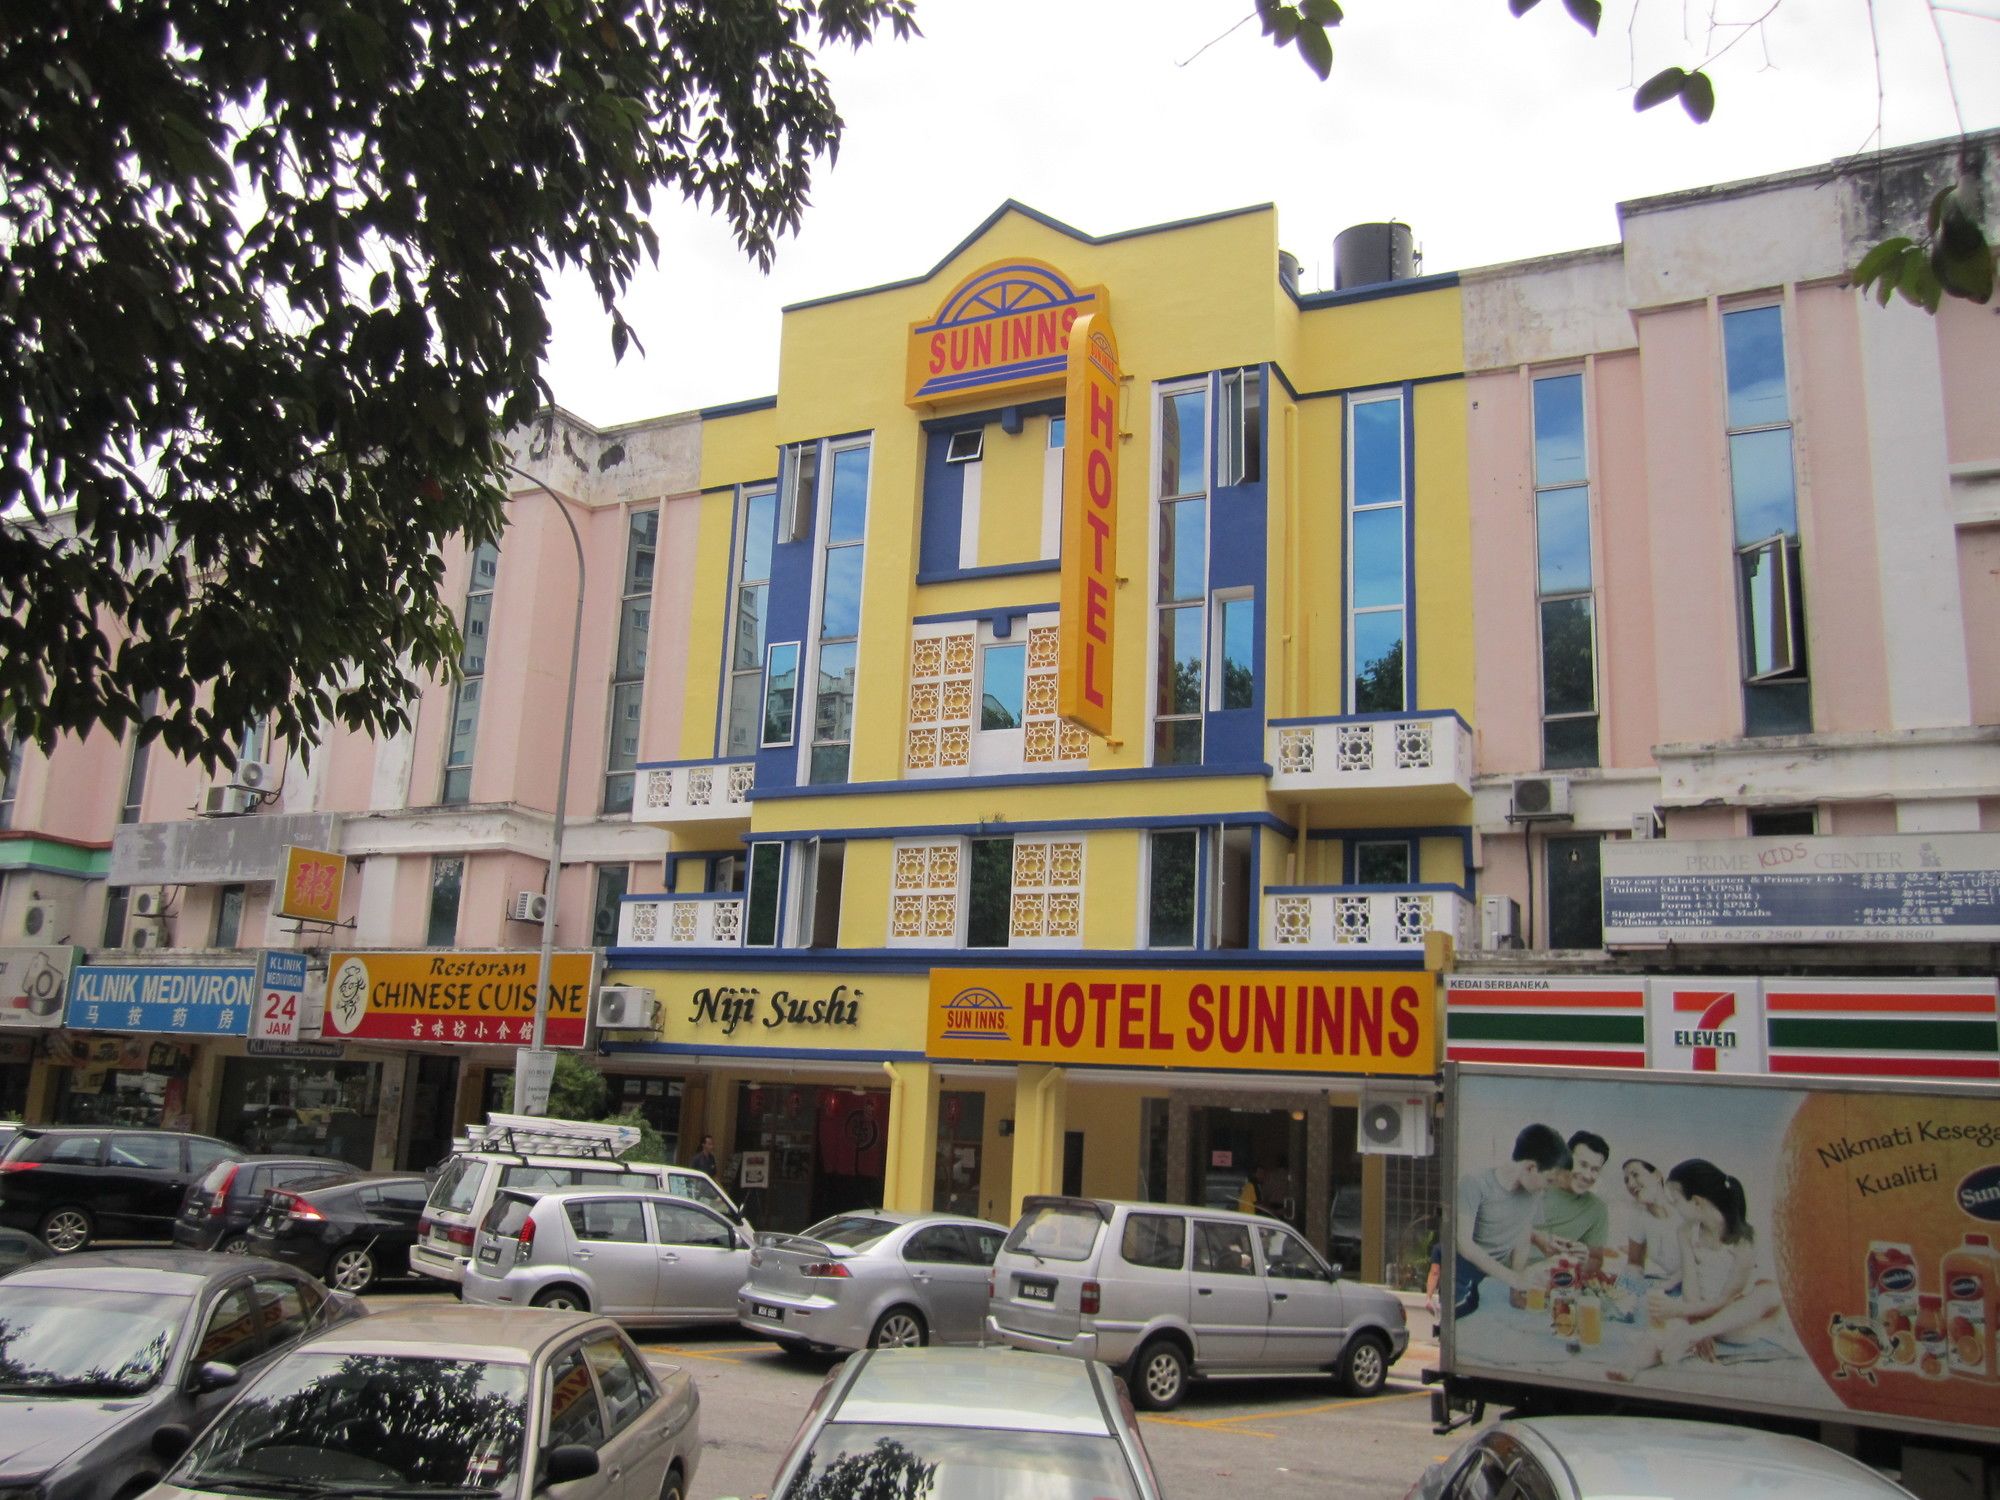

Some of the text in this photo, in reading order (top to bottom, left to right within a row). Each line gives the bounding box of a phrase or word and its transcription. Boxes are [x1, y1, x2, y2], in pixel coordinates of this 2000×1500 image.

[929, 323, 992, 374] SUN
[1001, 307, 1079, 362] INNS
[1085, 381, 1114, 709] HOTEL
[1686, 842, 1903, 871] PRIME KIDS CENTER
[265, 972, 303, 987] MEDIVIRON
[269, 957, 303, 972] KLINIK
[429, 957, 526, 976] Restoran
[76, 974, 254, 1005] KLINIK MEDIVIRON
[372, 981, 584, 1013] CHINESE CUISNE
[1450, 980, 1550, 990] KEDAI SERBANEKA
[264, 993, 297, 1020] 24
[688, 985, 865, 1034] Niji Sushi
[947, 1010, 1005, 1030] SUN INNS
[1022, 982, 1420, 1058] HOTEL SUN INNS
[266, 1022, 291, 1036] JAM
[1672, 991, 1736, 1071] 7
[1816, 1126, 1913, 1168] Nikmati
[1856, 1163, 1938, 1197] Kualiti
